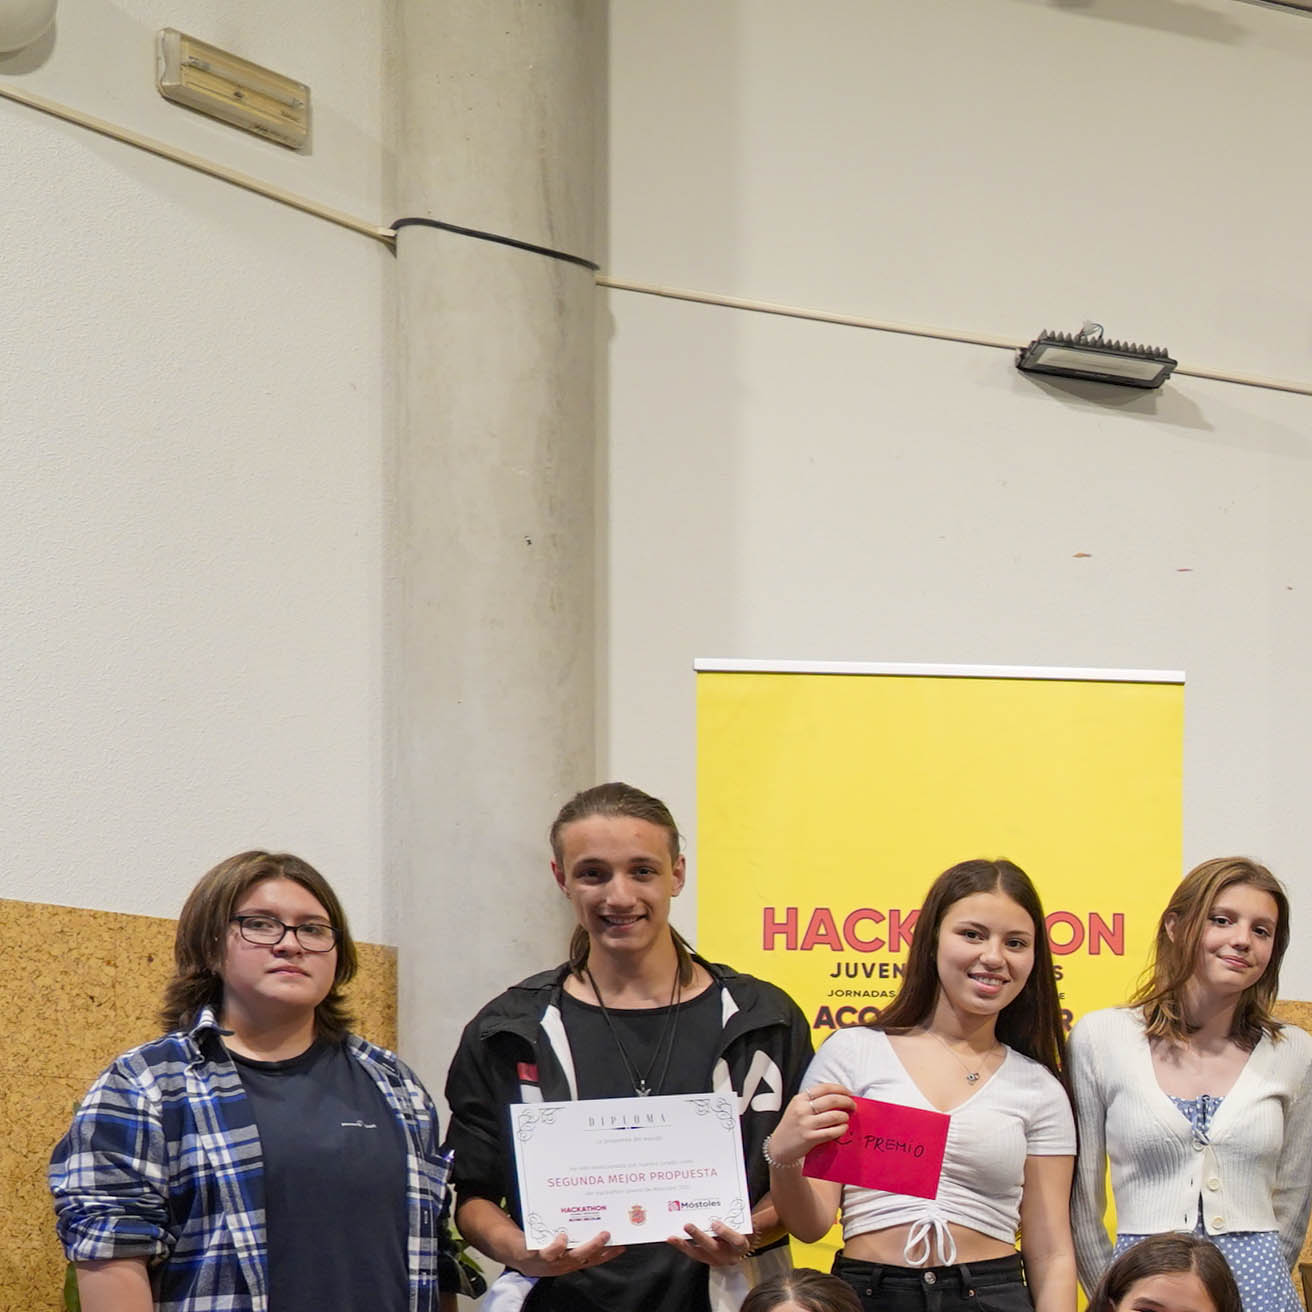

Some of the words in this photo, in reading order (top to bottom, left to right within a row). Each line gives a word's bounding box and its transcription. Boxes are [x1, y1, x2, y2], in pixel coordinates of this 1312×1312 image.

[763, 907, 1125, 956] HACKON
[830, 962, 906, 979] JUVEN
[828, 989, 897, 998] JORNADAS
[813, 1005, 881, 1029] ACO
[588, 1113, 668, 1128] DIPLOMA
[864, 1135, 925, 1158] PREMIO
[547, 1171, 605, 1188] SEGUNDA
[608, 1172, 646, 1185] MEJOR
[650, 1168, 718, 1182] PROPUESTA
[561, 1204, 608, 1214] HACKATHON
